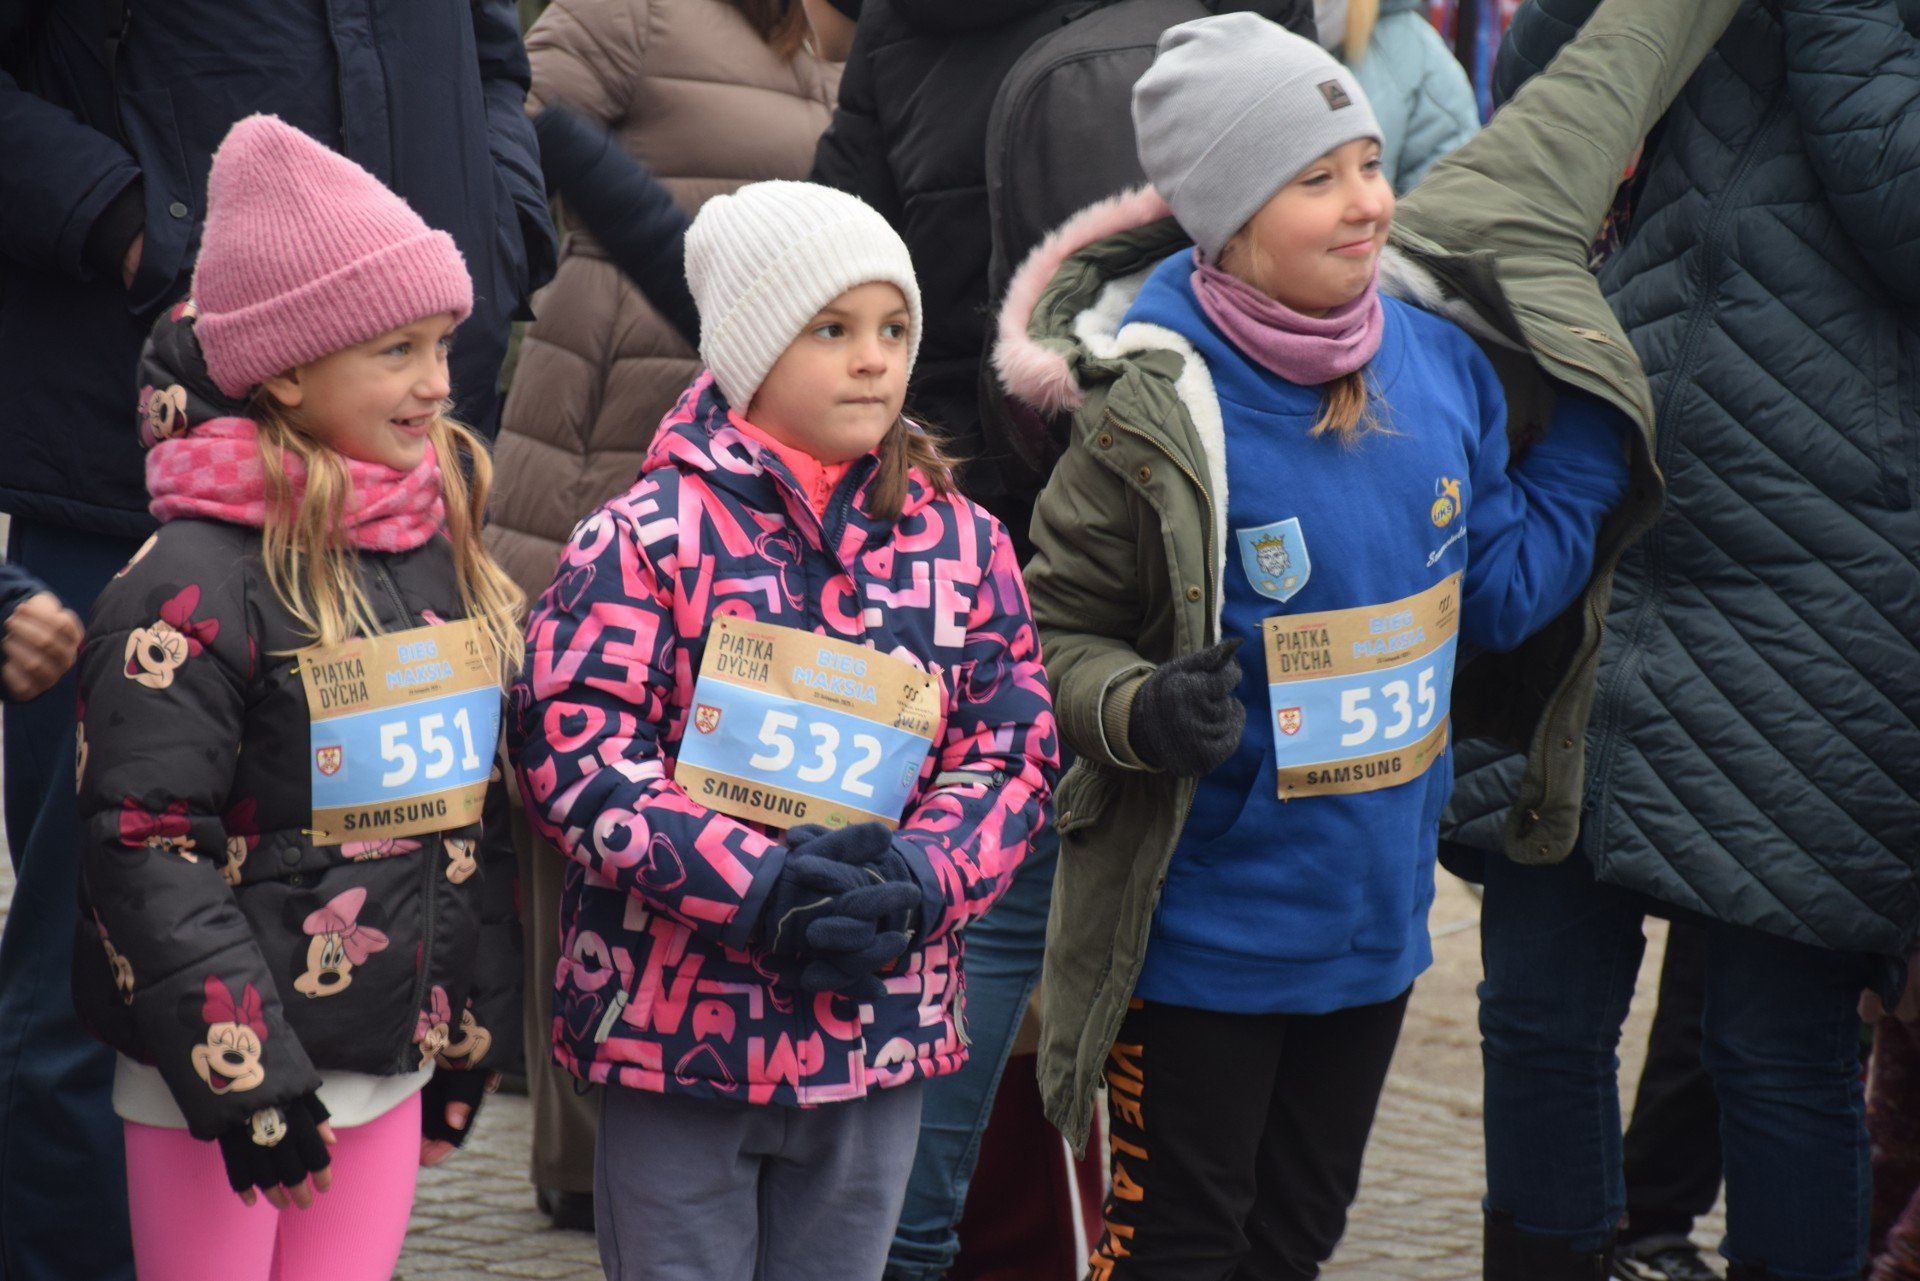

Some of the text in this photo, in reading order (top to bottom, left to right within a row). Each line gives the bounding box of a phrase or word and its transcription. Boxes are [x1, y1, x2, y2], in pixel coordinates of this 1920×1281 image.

[1369, 609, 1414, 635] BIEG
[398, 639, 438, 663] BIEG
[1352, 627, 1426, 659] MAKSIA
[312, 659, 365, 687] PIĄTKA
[386, 661, 454, 690] MAKSIA
[717, 653, 769, 683] DYCHA
[816, 648, 868, 678] BIEG
[1281, 650, 1332, 673] DYCHA
[320, 681, 369, 709] DYCHA
[791, 666, 877, 704] MAKSIA
[1340, 666, 1436, 747] 535
[379, 708, 480, 788] 551
[749, 709, 883, 798] 532
[1306, 757, 1402, 785] SAMSUNG
[702, 778, 807, 818] SAMSUNG
[343, 799, 448, 831] SAMSUNG
